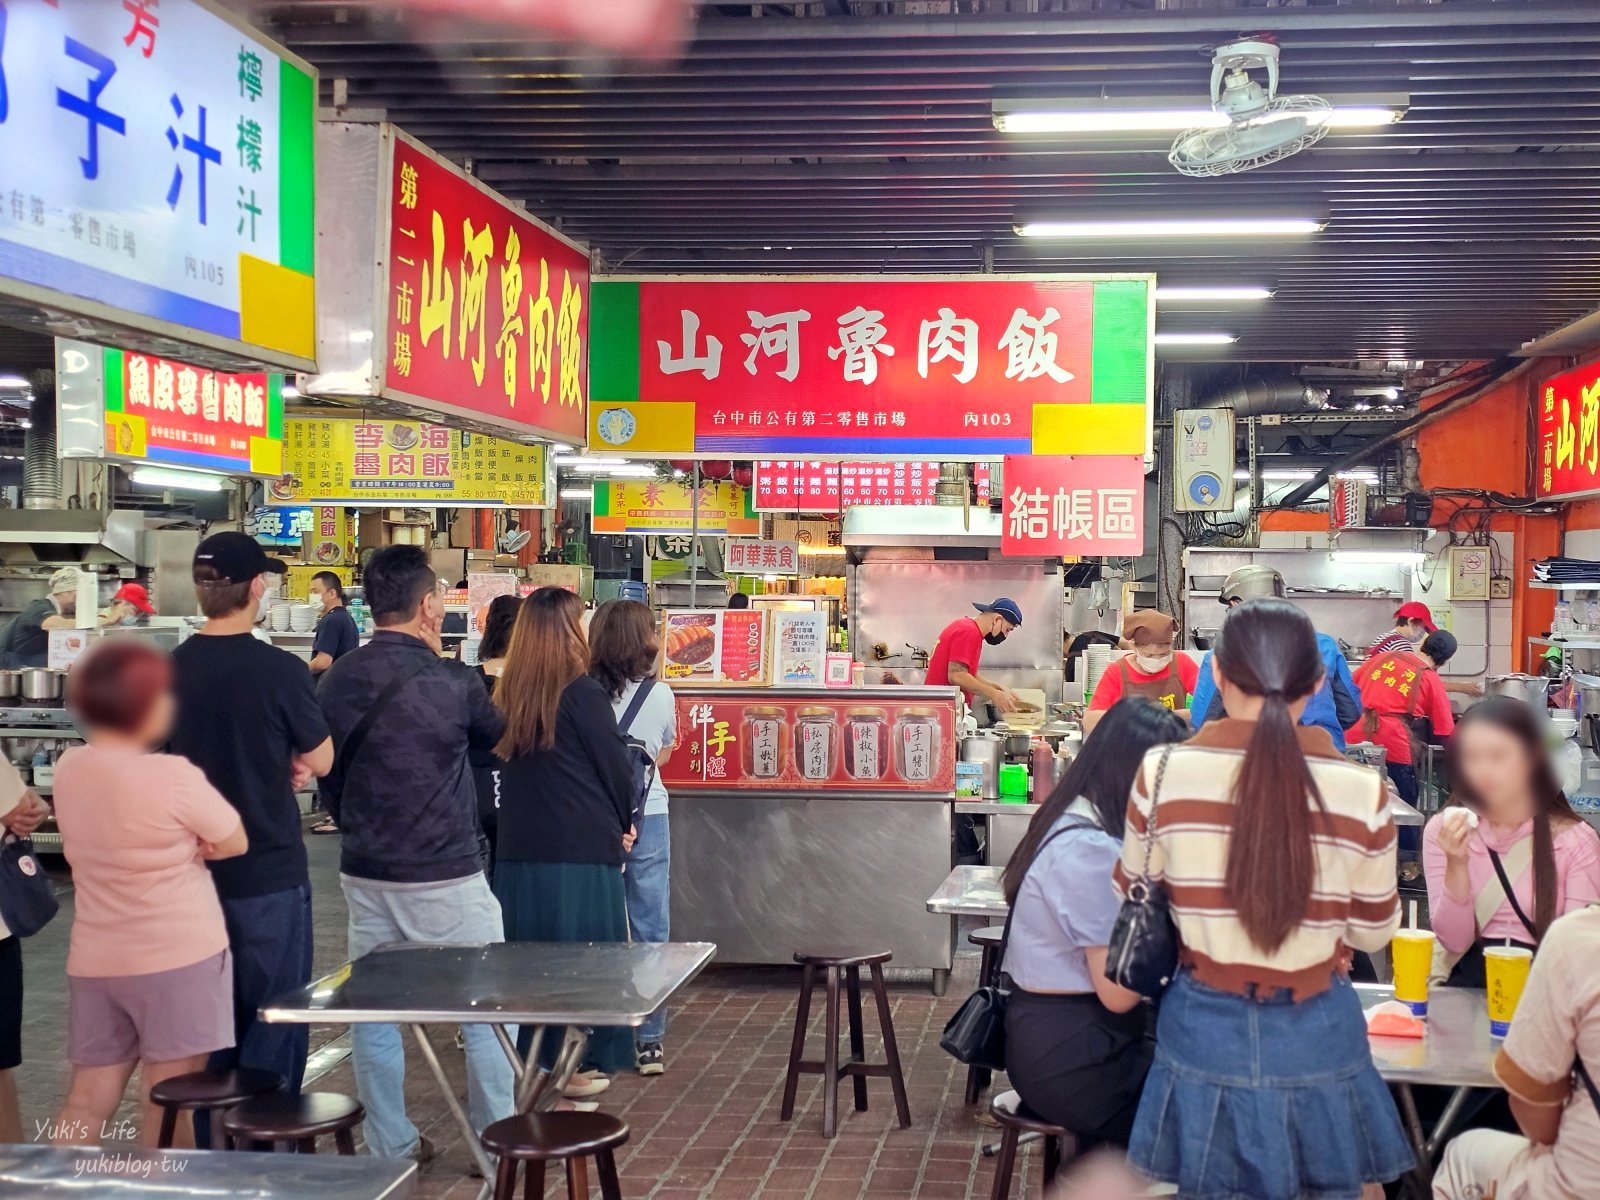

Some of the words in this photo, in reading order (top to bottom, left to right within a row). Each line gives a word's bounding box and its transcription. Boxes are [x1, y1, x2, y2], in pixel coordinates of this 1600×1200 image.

[237, 44, 263, 243] 檸檬汁
[0, 189, 136, 259] 有第二零售市場
[184, 252, 224, 286] 內105
[393, 161, 418, 378] 第二市場
[419, 210, 584, 416] 山河魯肉飯
[657, 306, 1075, 385] 山河魯肉飯
[711, 408, 906, 427] 台中市公有第二零售市場
[963, 410, 1013, 427] 內103
[354, 423, 384, 448] 李
[420, 424, 449, 448] 海
[1543, 387, 1554, 492] 第二市場
[354, 452, 450, 476] 魯肉飯
[498, 490, 507, 498] 70
[760, 487, 771, 495] 70
[777, 487, 788, 495] 80
[793, 487, 804, 495] 60
[810, 487, 821, 495] 80
[1009, 486, 1137, 540] 結帳區
[730, 544, 793, 569] 阿華素食
[1371, 670, 1412, 697] 魯肉飯
[1382, 661, 1416, 682] 山河
[689, 704, 736, 781] 伴手禮
[690, 741, 701, 773] 系列
[859, 726, 873, 777] 辣椒小魚
